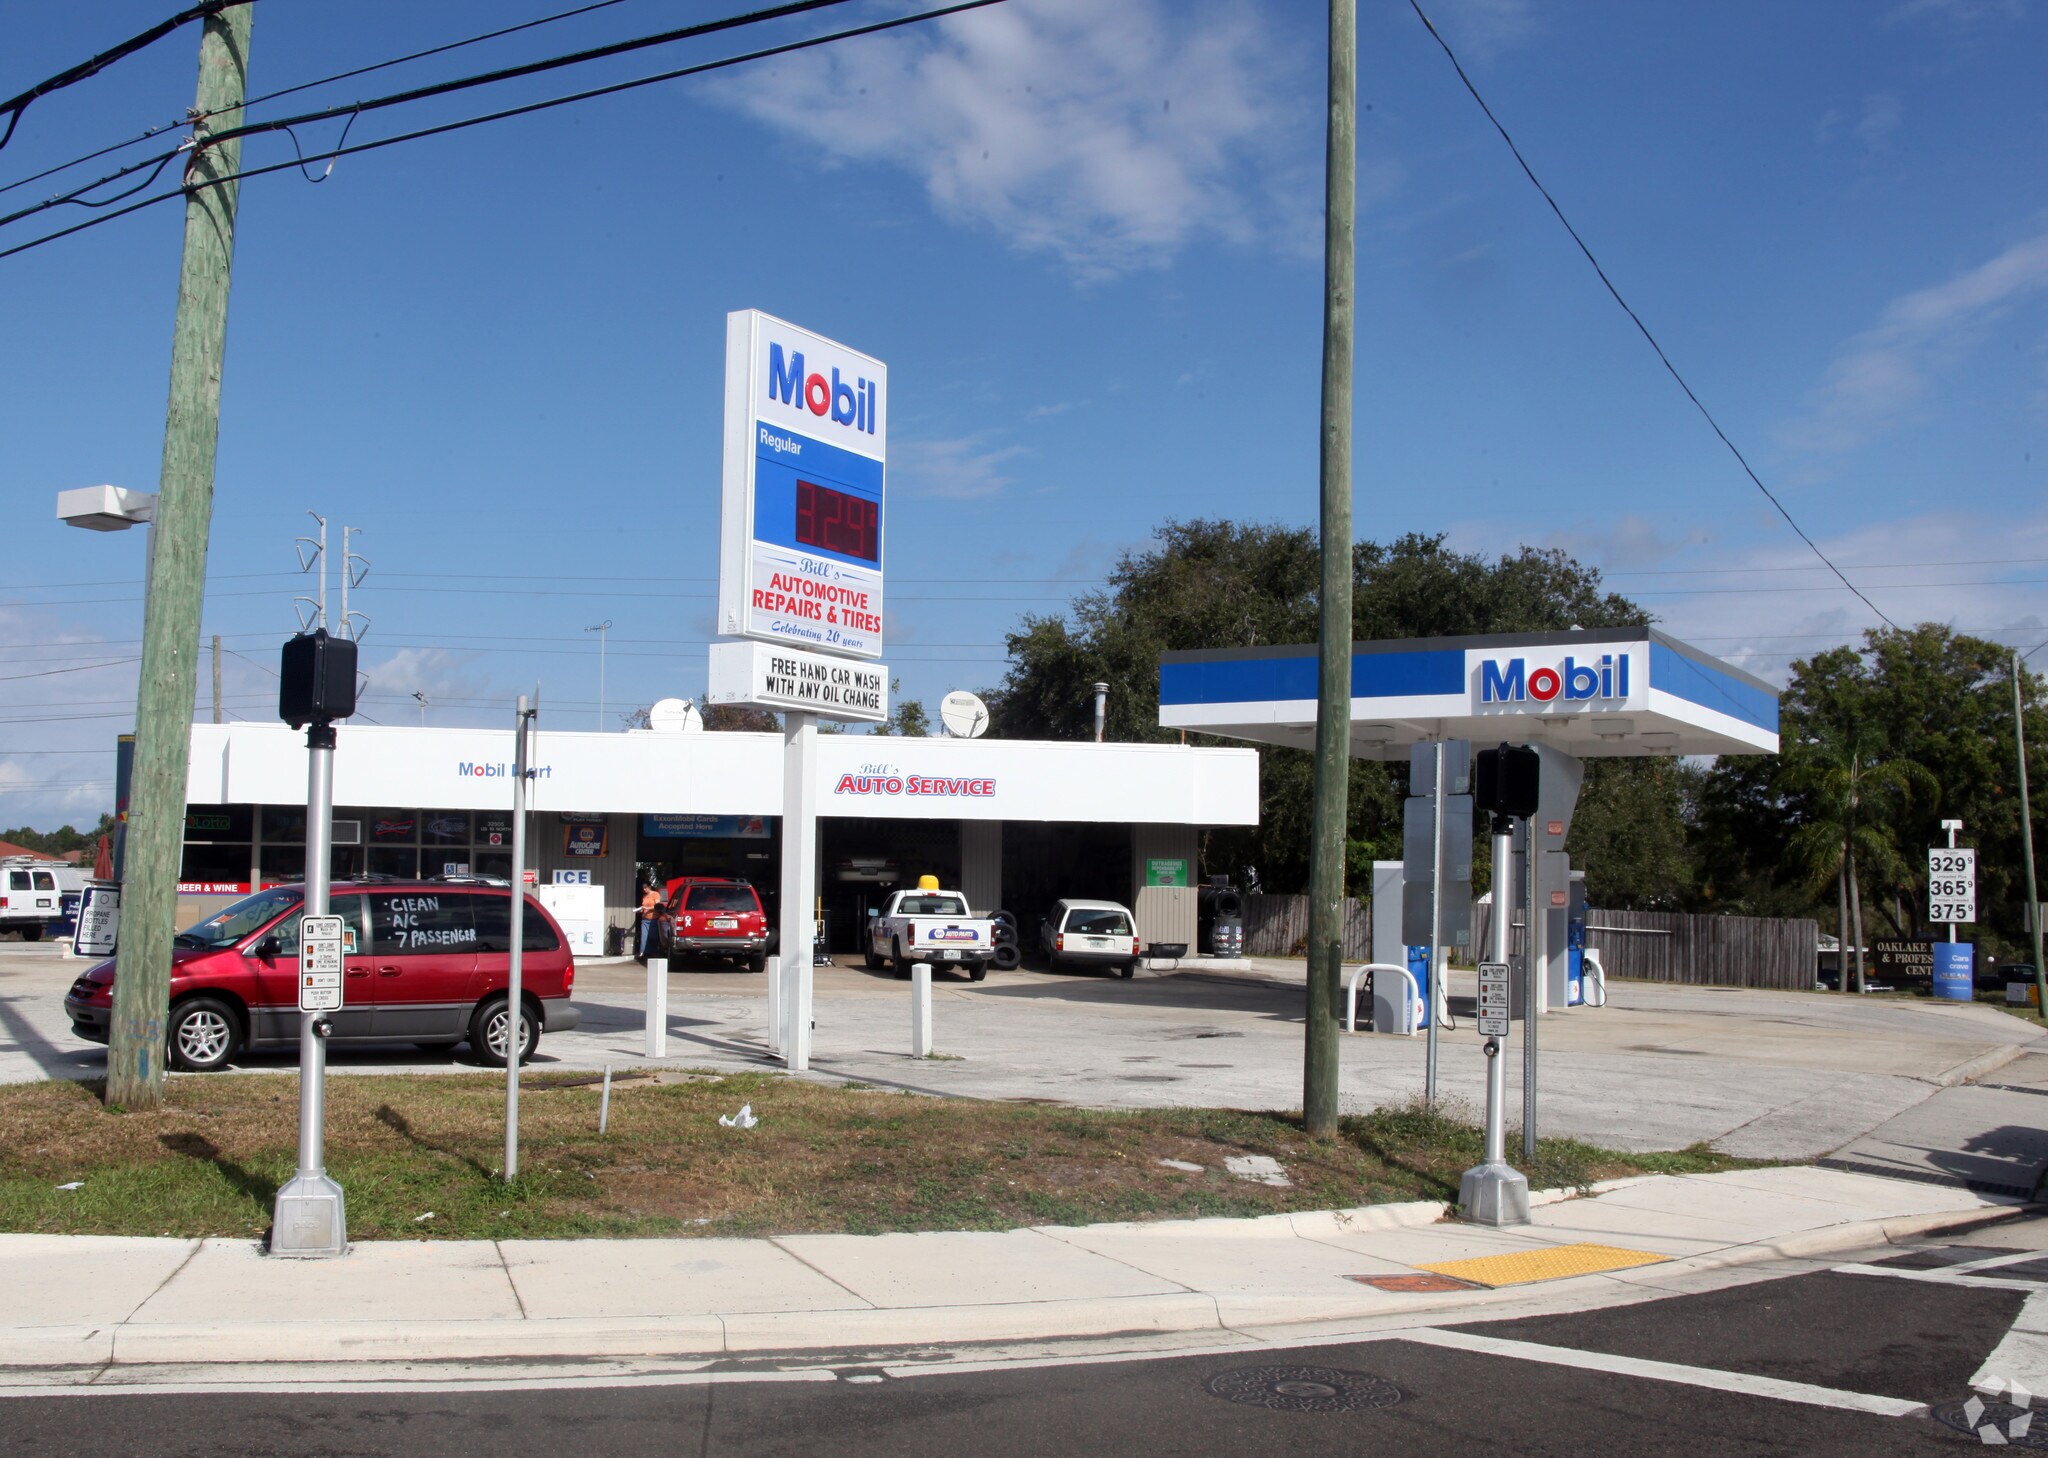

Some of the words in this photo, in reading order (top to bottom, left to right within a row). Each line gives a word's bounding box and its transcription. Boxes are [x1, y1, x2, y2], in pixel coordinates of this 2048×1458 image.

[769, 341, 876, 435] Mobil
[760, 428, 801, 455] Regular
[800, 558, 840, 580] Bill's
[770, 573, 868, 610] AUTOMOTIVE
[753, 589, 822, 621] REPAIRS
[827, 606, 837, 624] &
[842, 608, 881, 633] TIRES
[771, 620, 822, 642] Celebrating
[826, 629, 840, 643] 20
[842, 637, 863, 648] years
[771, 657, 797, 677] FREE
[800, 662, 828, 681] HAND
[831, 668, 850, 685] CAR
[854, 672, 880, 691] WASH
[1481, 654, 1629, 703] Mobil
[766, 676, 794, 696] WITH
[798, 682, 820, 699] ANY
[823, 685, 839, 703] OIL
[843, 689, 880, 709] CHANGE
[459, 762, 505, 777] Mobil
[859, 763, 899, 774] Bill's
[835, 774, 904, 795] AUTO
[906, 775, 996, 797] SERVICE
[653, 814, 695, 822] ExxonMobil
[658, 823, 693, 831] Accepted
[556, 872, 588, 884] ICE
[177, 884, 202, 892] BEER
[204, 884, 211, 892] &
[212, 884, 238, 892] WINE
[84, 917, 108, 925] BOTTLES
[393, 913, 419, 929] A/C
[395, 931, 408, 948] 7
[411, 928, 477, 948] PASSENGER
[1877, 942, 1927, 952] OAKLAKE
[1882, 953, 1891, 963] &
[1951, 954, 1969, 962] Cars
